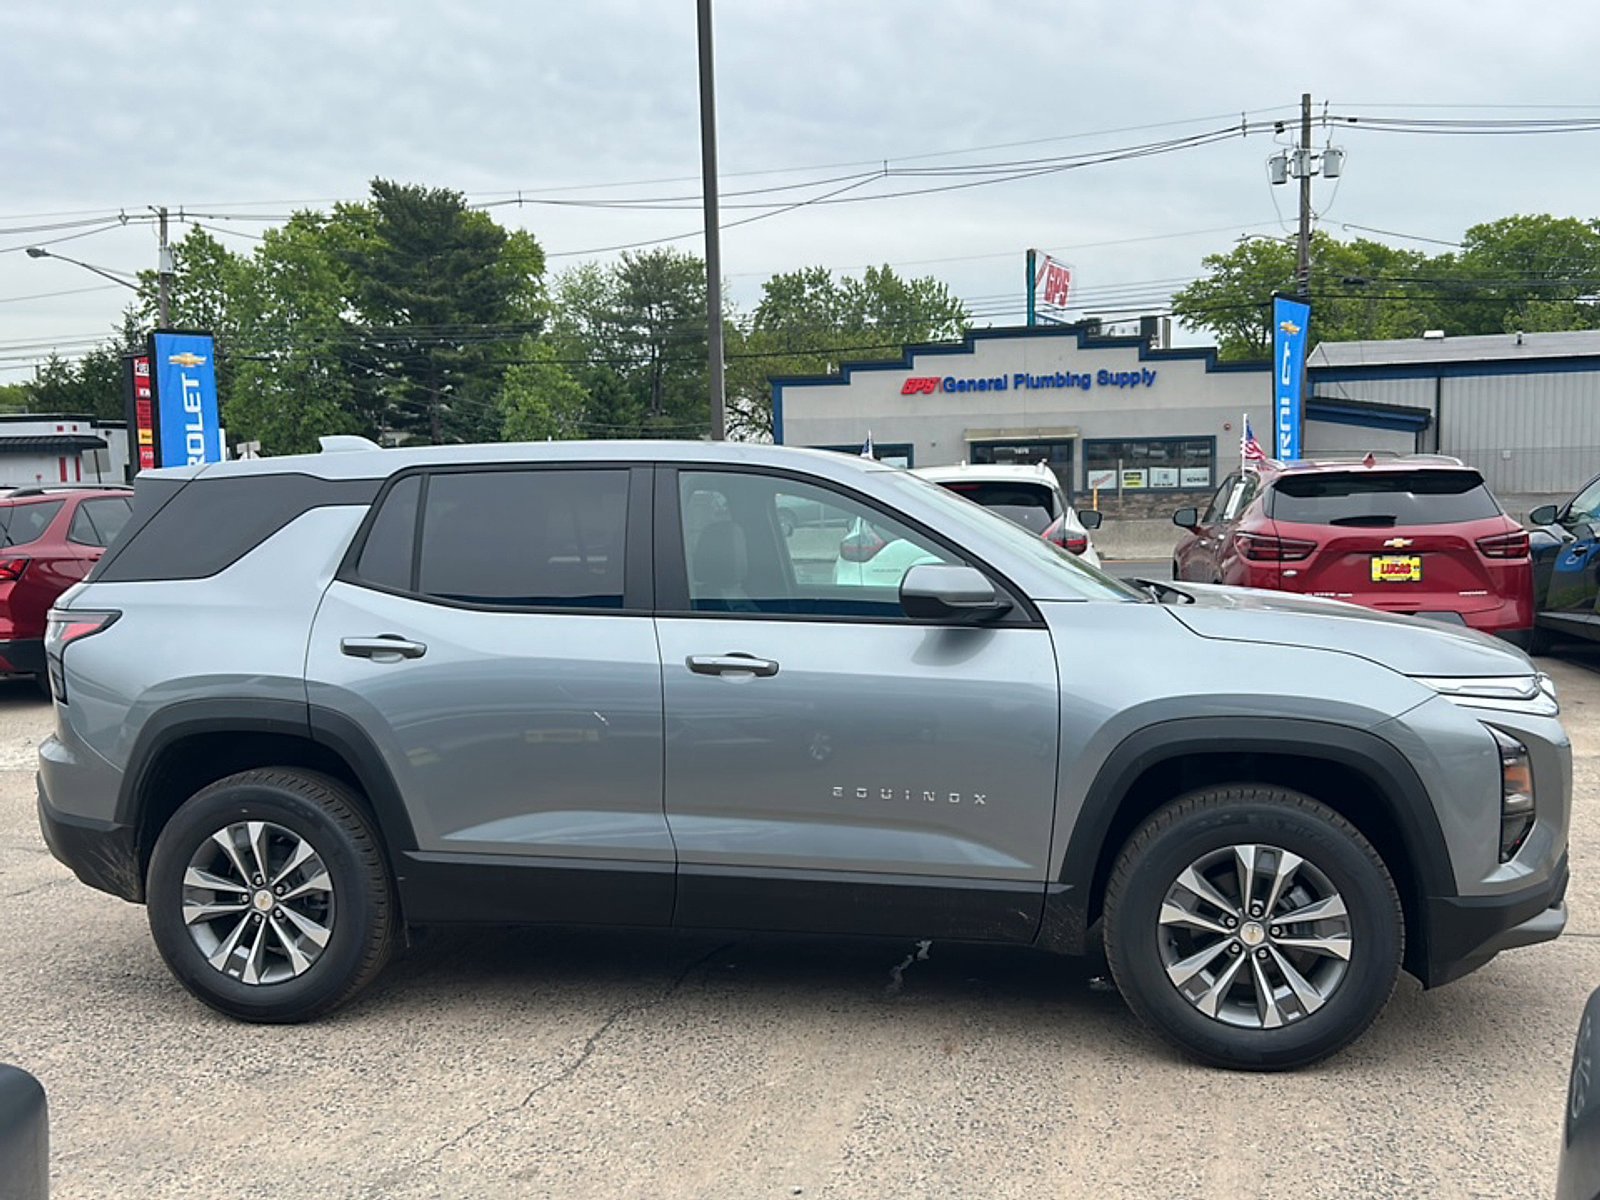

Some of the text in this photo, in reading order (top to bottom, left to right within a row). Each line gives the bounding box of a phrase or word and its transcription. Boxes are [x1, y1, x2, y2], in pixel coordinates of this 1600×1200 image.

[1044, 264, 1070, 307] GPS
[901, 367, 1157, 395] GPS General Plumbing Supply
[832, 786, 988, 805] EQUINOX
